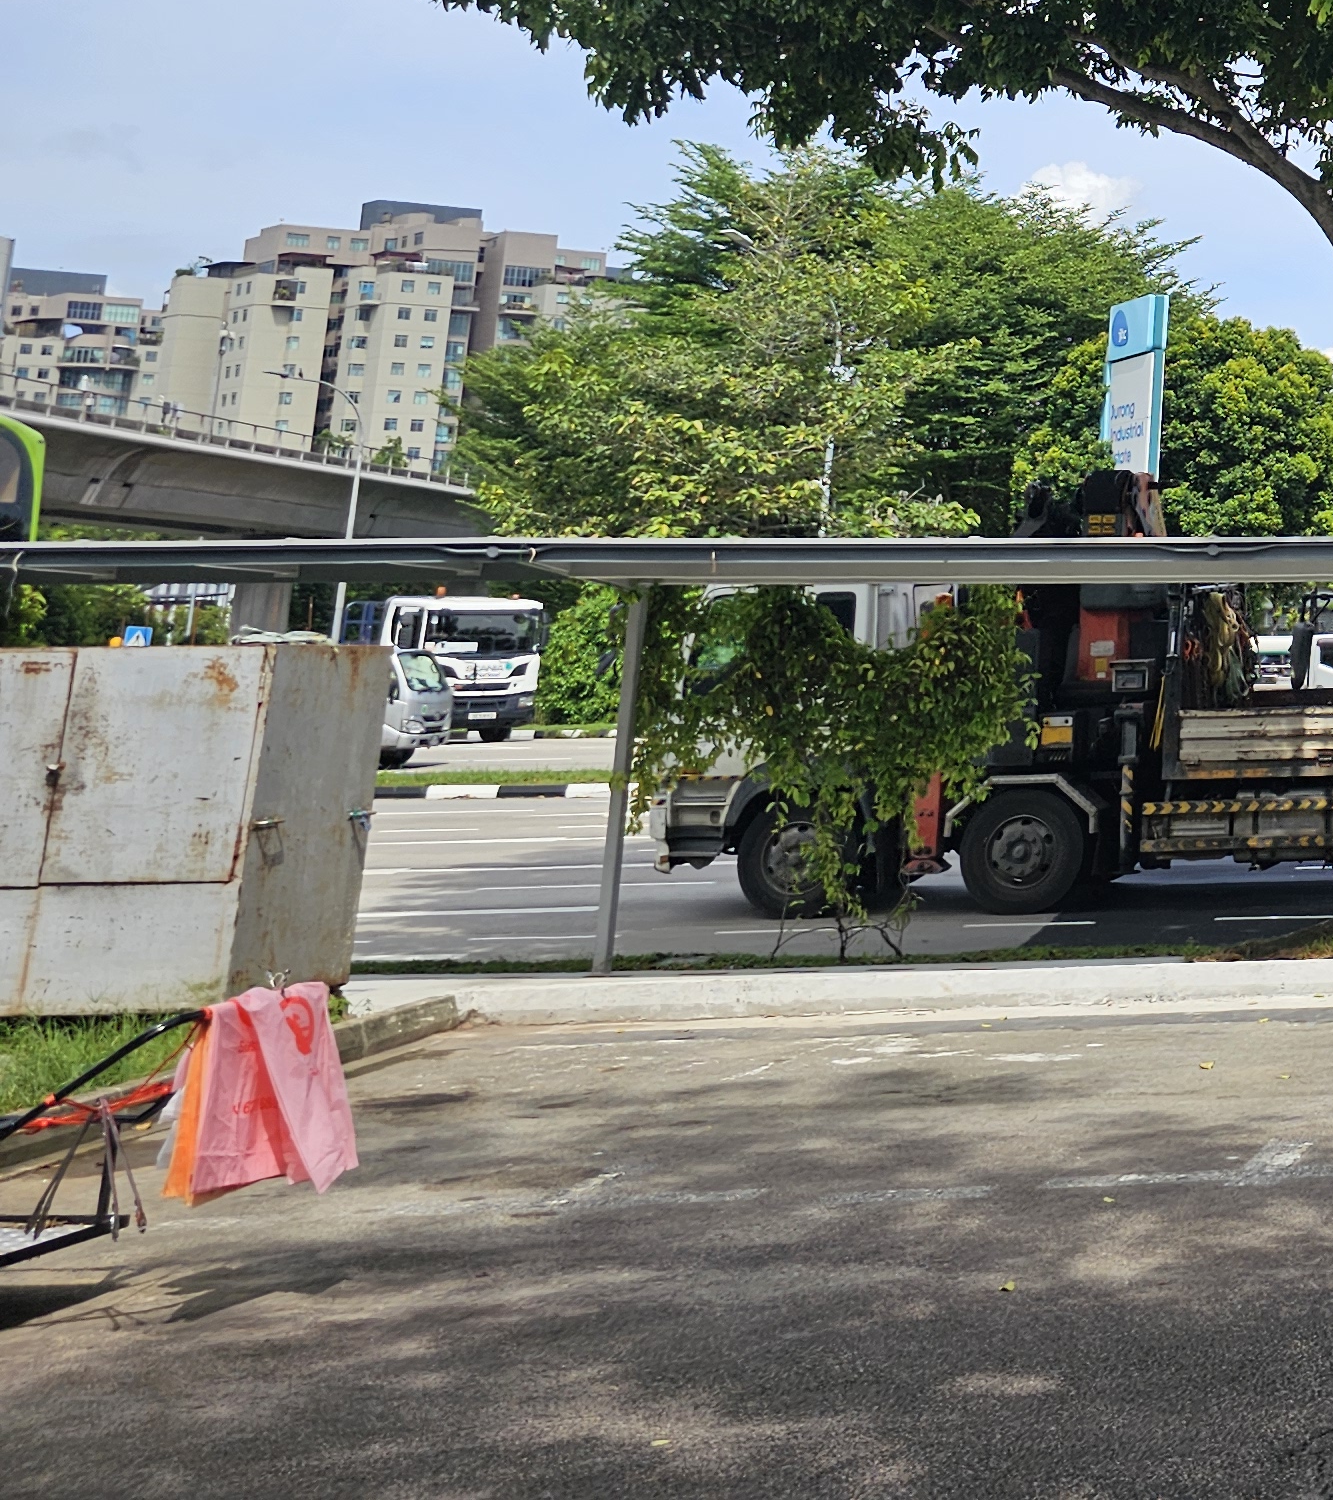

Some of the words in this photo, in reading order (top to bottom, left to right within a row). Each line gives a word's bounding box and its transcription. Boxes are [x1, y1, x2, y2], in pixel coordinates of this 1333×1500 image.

[1110, 402, 1135, 420] Jurong
[1110, 421, 1144, 442] Industrial
[1113, 448, 1132, 464] state
